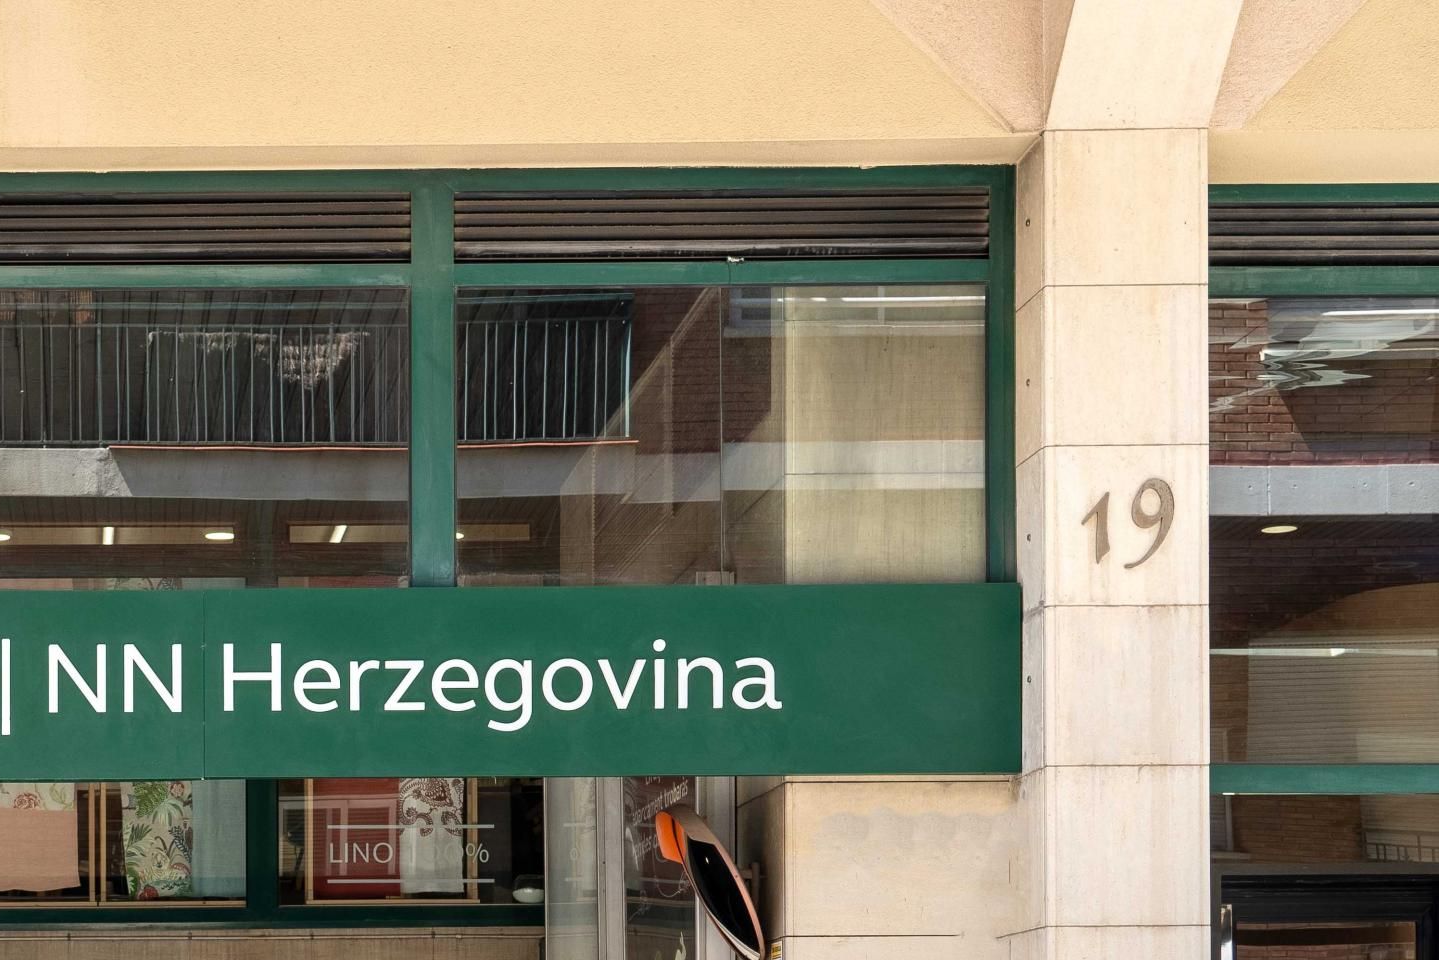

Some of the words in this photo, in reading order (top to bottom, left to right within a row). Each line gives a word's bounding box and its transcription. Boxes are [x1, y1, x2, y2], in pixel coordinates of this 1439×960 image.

[1081, 478, 1175, 569] 19
[48, 643, 182, 713] NN
[223, 638, 783, 732] Herzegovina
[329, 842, 394, 864] LINO
